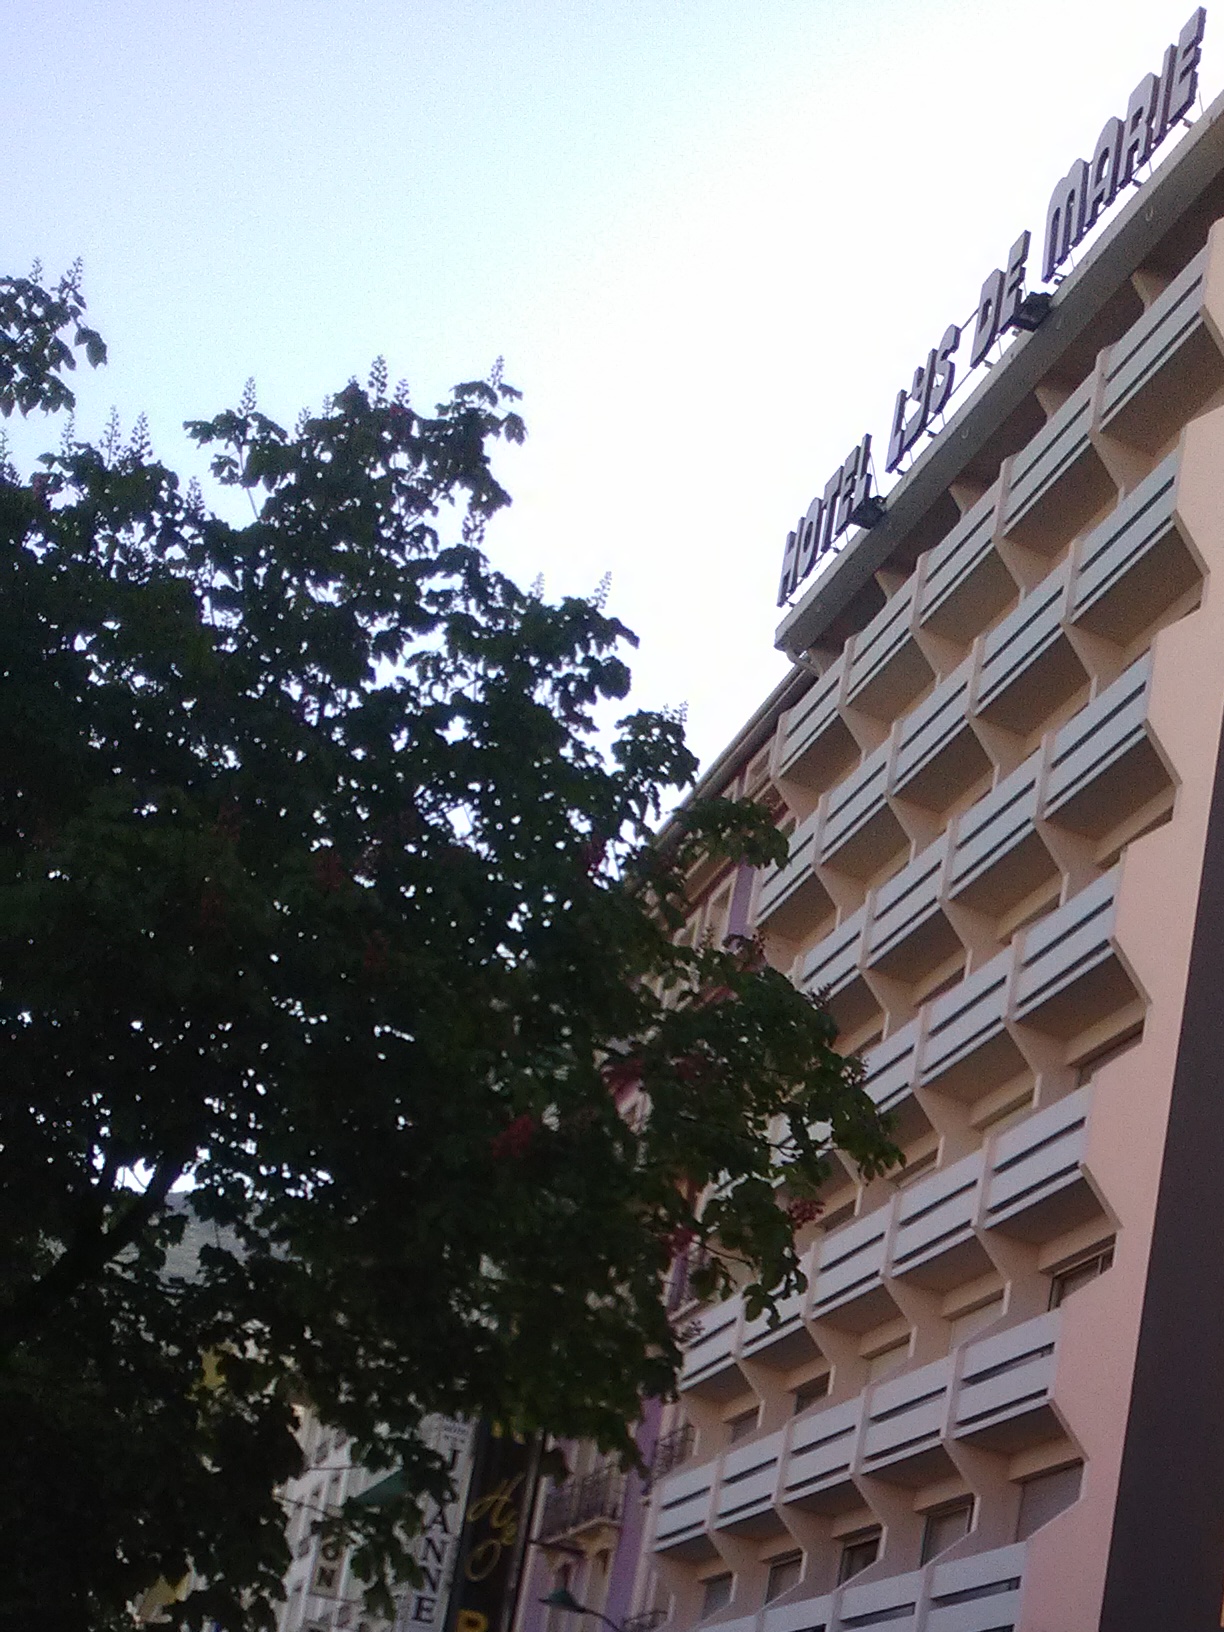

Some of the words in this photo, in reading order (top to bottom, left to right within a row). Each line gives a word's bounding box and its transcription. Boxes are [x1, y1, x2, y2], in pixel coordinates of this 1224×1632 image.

[776, 433, 873, 607] HOTEL
[885, 324, 961, 474] LYS
[970, 230, 1031, 369] DE
[1041, 6, 1207, 283] MARIE
[413, 1449, 463, 1624] JANNE
